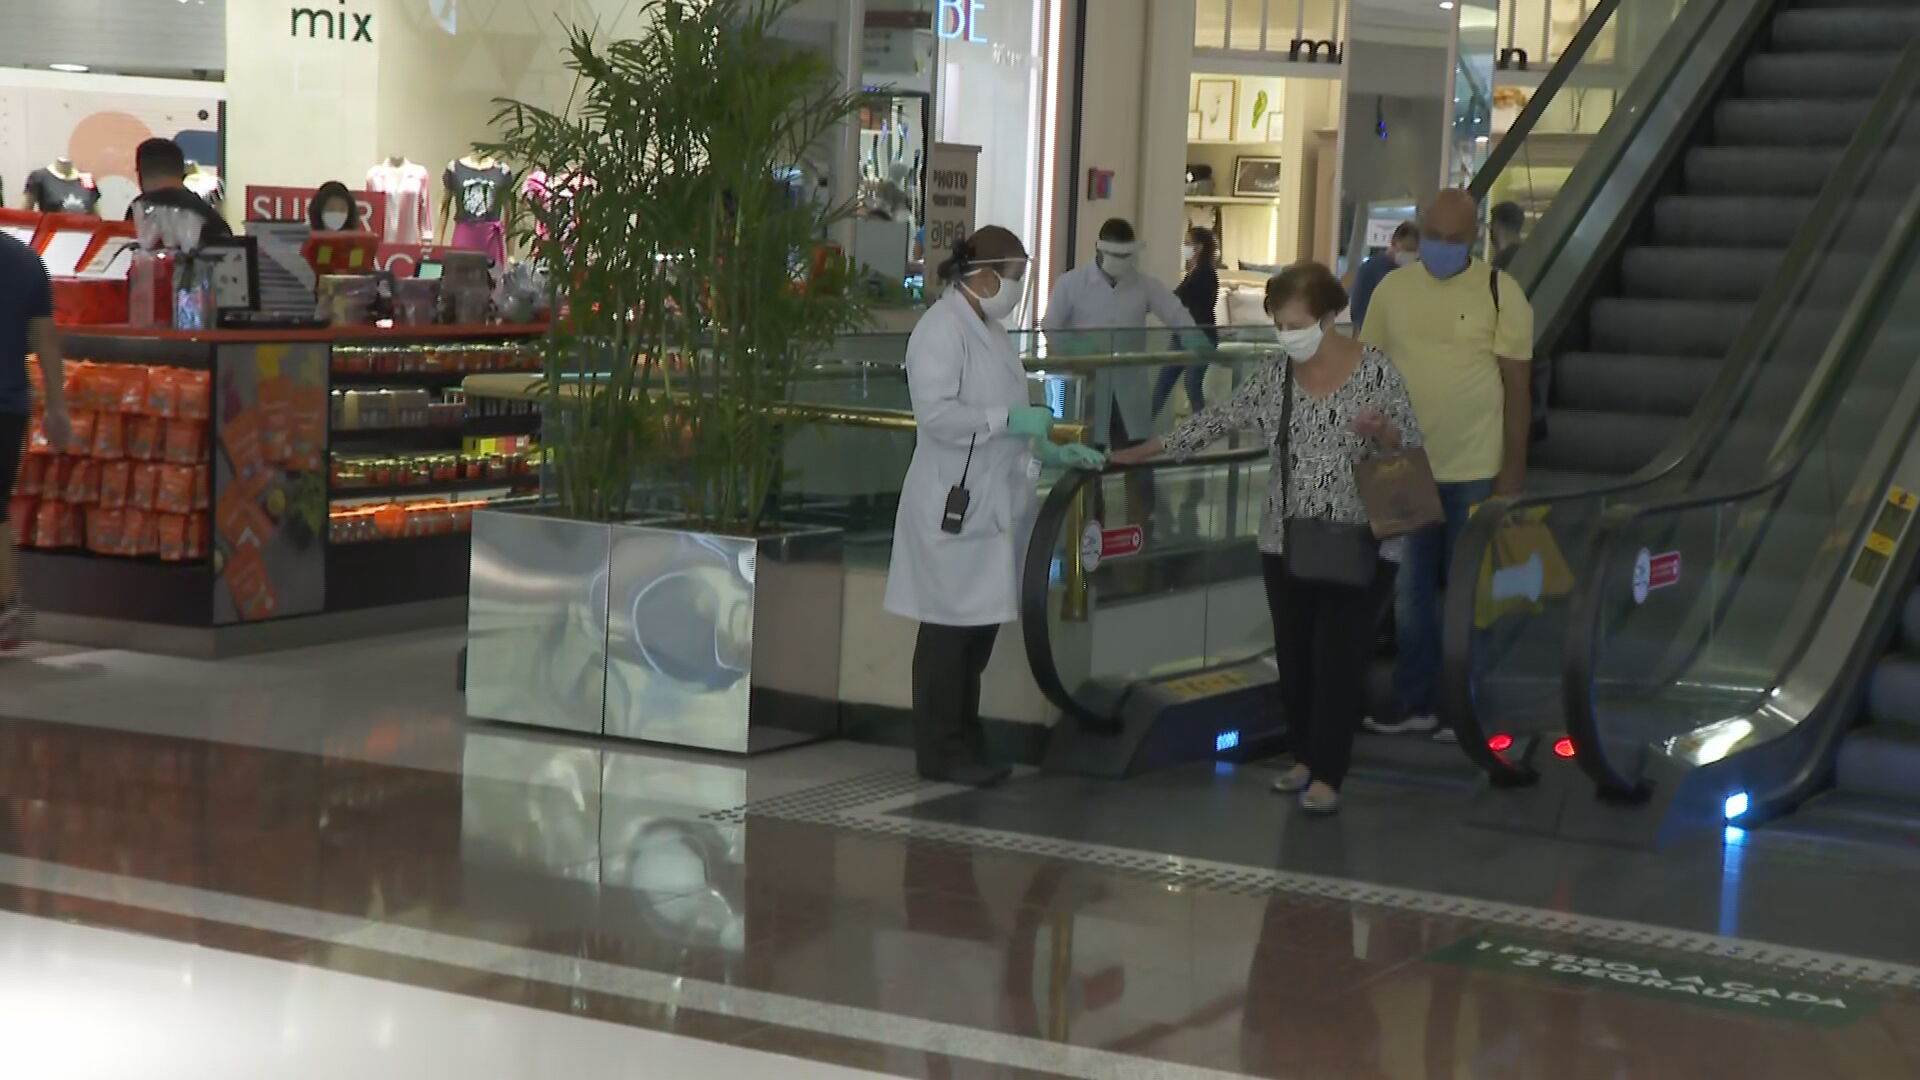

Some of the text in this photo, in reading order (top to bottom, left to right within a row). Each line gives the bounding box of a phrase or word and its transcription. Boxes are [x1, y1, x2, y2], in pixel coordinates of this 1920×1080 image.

[291, 0, 373, 42] mix
[1500, 945, 1663, 979] PESSOA
[1721, 981, 1847, 1009] CADA
